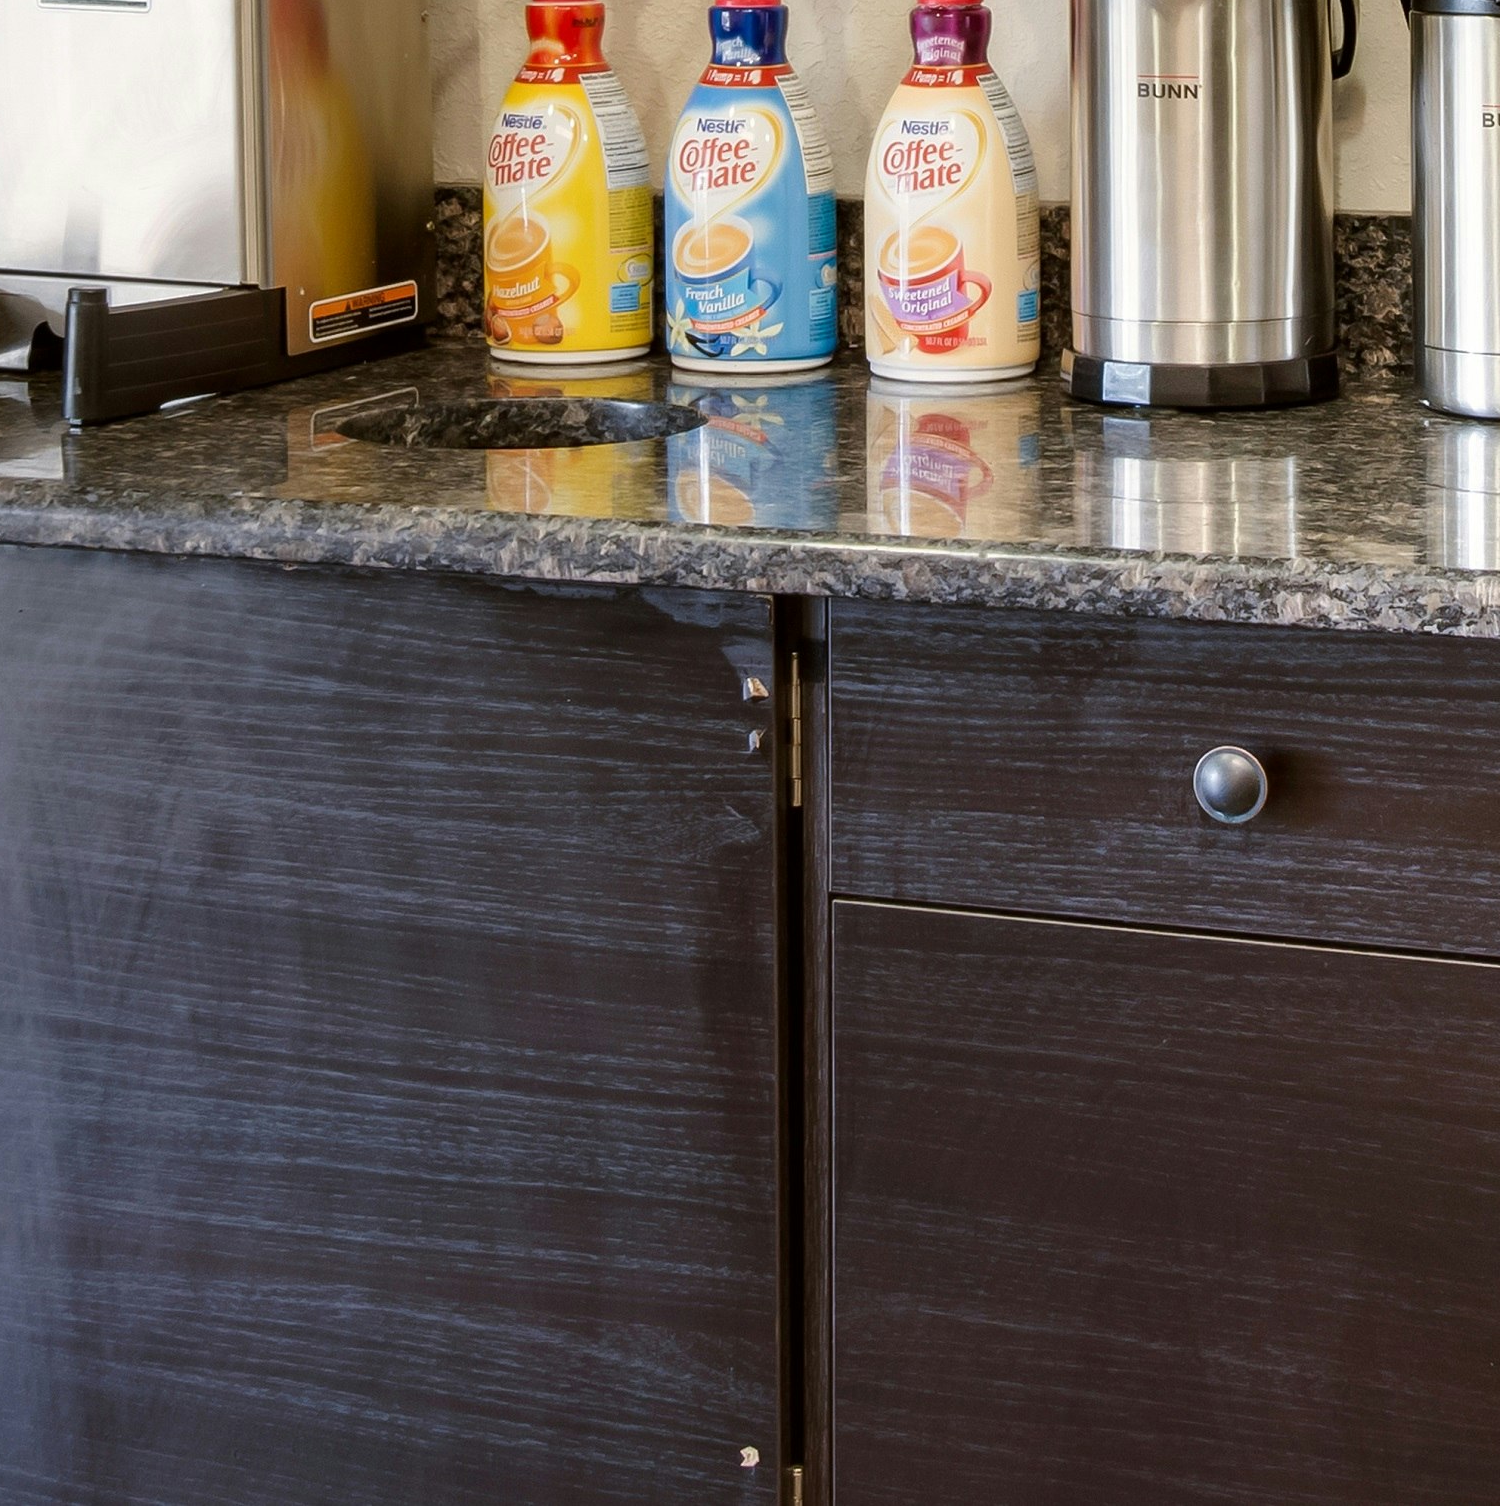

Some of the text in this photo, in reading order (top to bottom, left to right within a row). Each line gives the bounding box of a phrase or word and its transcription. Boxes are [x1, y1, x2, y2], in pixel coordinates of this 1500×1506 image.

[1137, 83, 1198, 99] BUNN
[494, 156, 552, 186] mate
[492, 276, 541, 298] Hazelnut
[685, 284, 725, 301] French
[888, 276, 950, 300] Sweetened
[698, 292, 746, 314] Vanilla
[901, 291, 952, 315] Original
